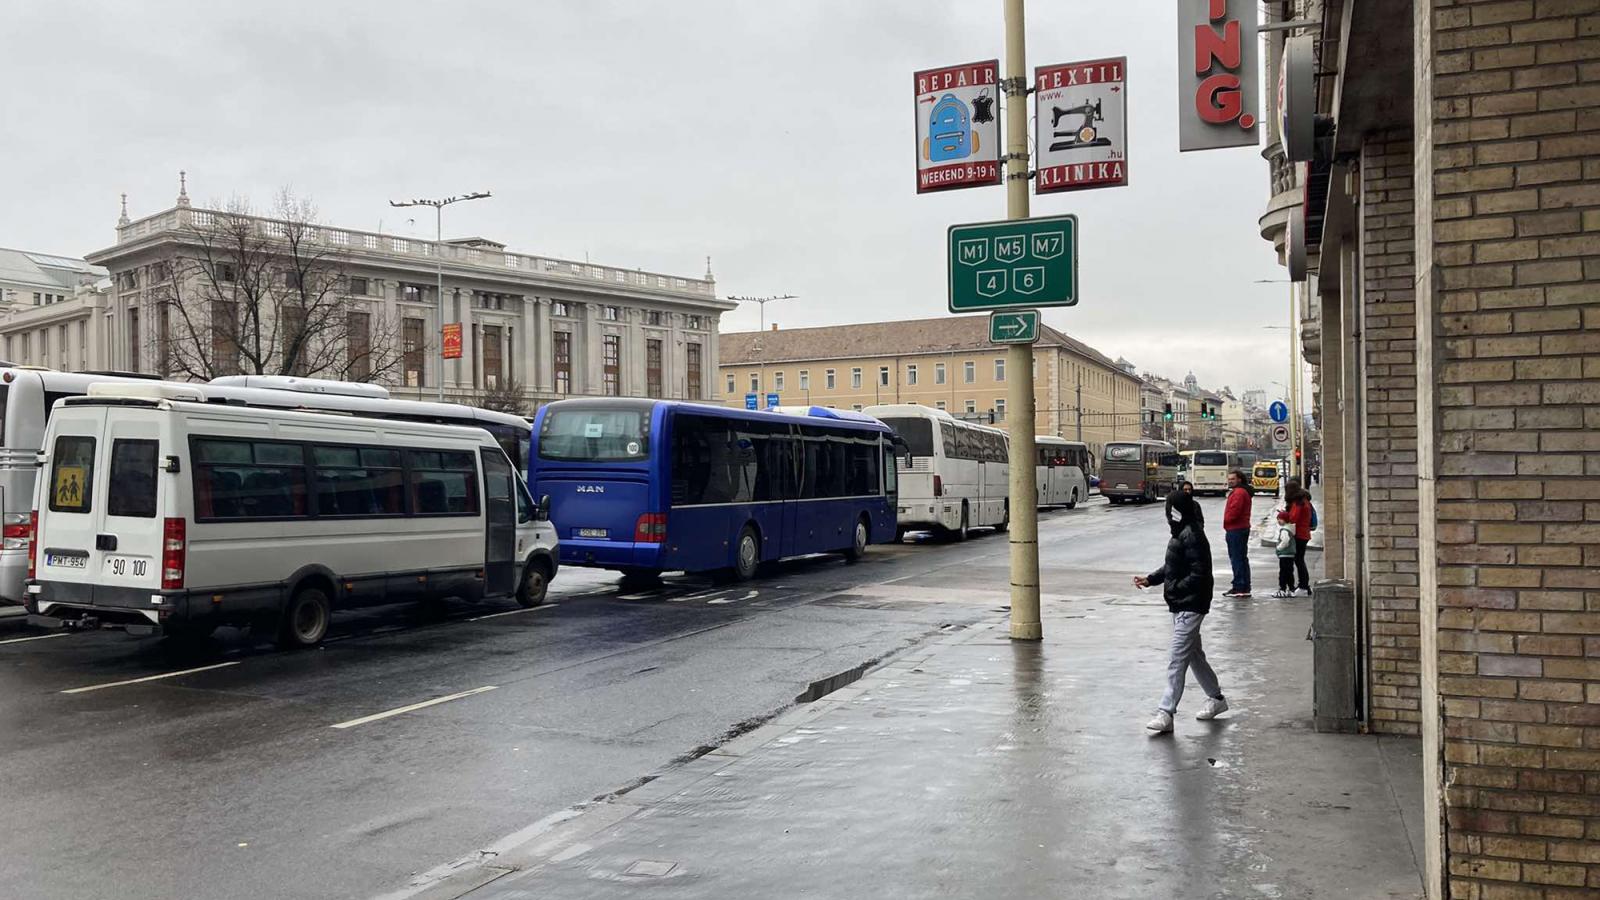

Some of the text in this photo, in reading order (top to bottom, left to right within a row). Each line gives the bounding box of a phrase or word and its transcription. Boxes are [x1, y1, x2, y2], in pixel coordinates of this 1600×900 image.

[919, 68, 994, 93] REPAIR
[1039, 65, 1122, 90] TEXTIL
[1040, 92, 1064, 102] www.
[1107, 149, 1123, 159] .hu
[921, 165, 996, 185] WEEKEND 9-19 h
[1040, 163, 1123, 186] KLINIKA
[964, 238, 1060, 259] M1 M5 M7
[987, 273, 1034, 290] 4 6
[576, 485, 604, 493] MAN
[52, 556, 84, 567] PMT-954
[113, 558, 147, 576] 90 100
